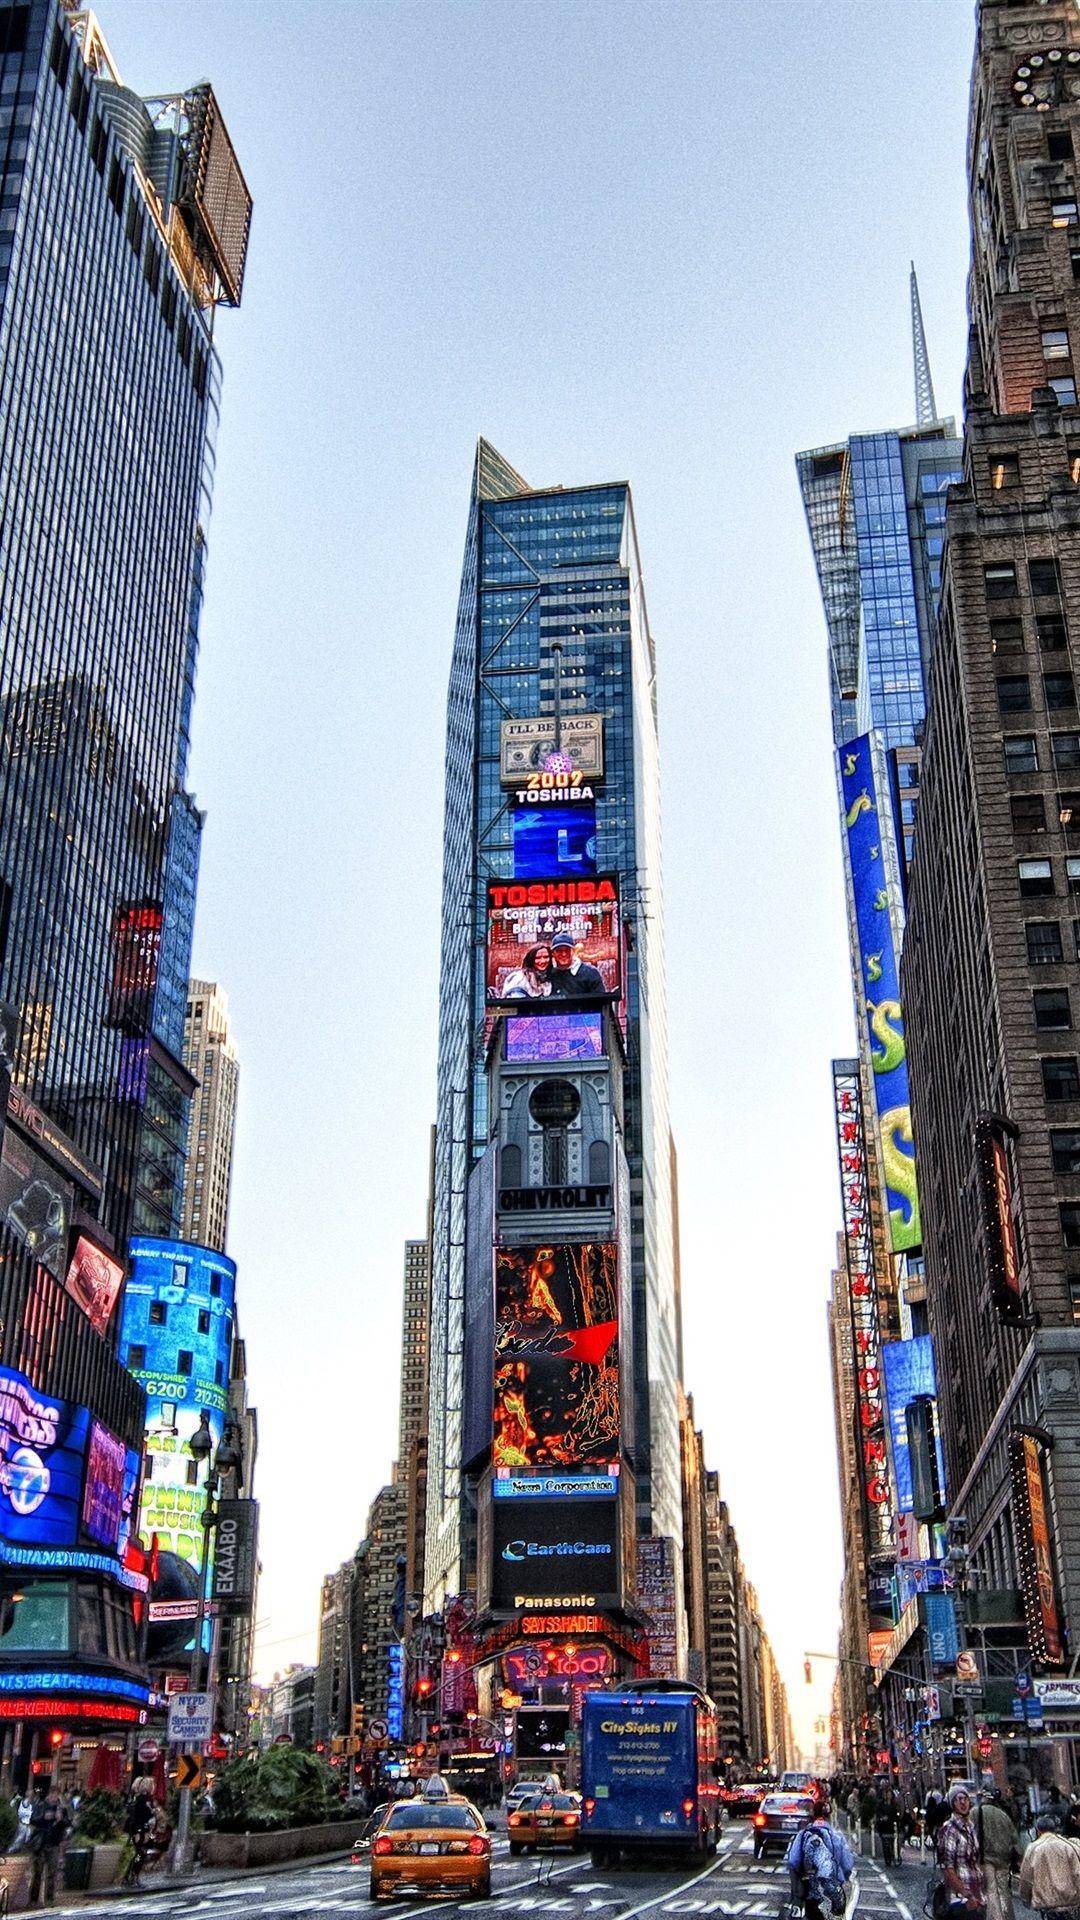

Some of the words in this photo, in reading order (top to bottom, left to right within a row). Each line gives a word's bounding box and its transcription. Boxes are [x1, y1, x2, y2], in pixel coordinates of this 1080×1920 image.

[508, 725, 534, 734] I'LL
[537, 723, 554, 732] BE
[560, 720, 594, 731] BACK
[516, 787, 595, 803] TOSHIBA
[489, 880, 616, 906] TOSHIBA
[503, 905, 602, 920] Congratulations
[512, 923, 542, 934] Beth
[543, 922, 554, 932] &
[555, 920, 592, 931] Justin
[500, 1187, 609, 1211] CHEVROLET
[146, 1381, 187, 1399] 6200
[511, 1480, 542, 1493] News
[545, 1479, 613, 1495] Corporation
[526, 1542, 611, 1556] EarthCam
[514, 1595, 596, 1608] Panasonic
[932, 1632, 947, 1660] UNO
[178, 1696, 206, 1705] NYPD
[171, 1715, 209, 1726] SECURITY
[600, 1720, 661, 1736] CitySights
[172, 1725, 207, 1735] CAMERA
[661, 1900, 780, 1917] ONL
